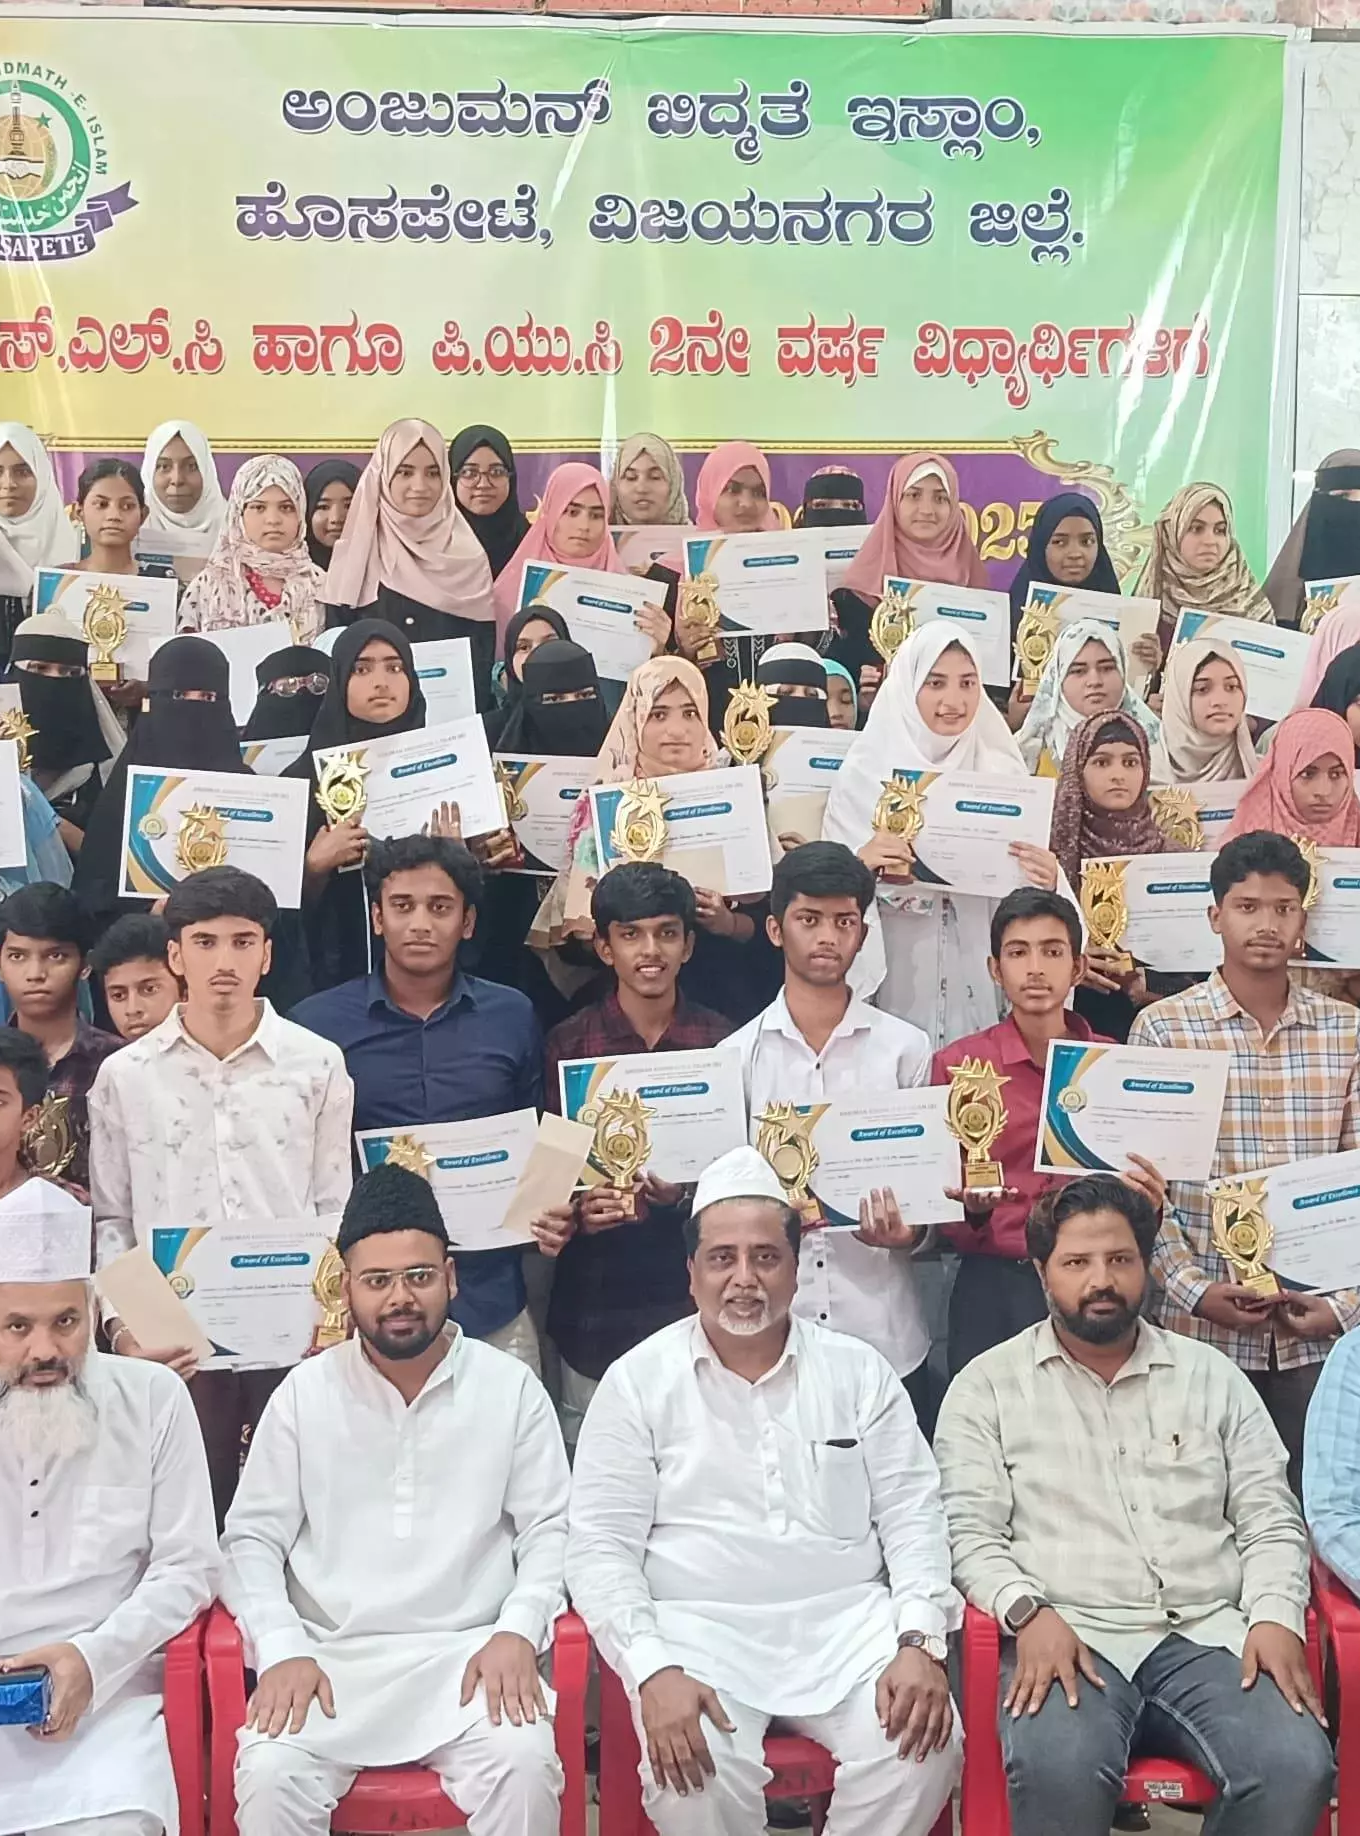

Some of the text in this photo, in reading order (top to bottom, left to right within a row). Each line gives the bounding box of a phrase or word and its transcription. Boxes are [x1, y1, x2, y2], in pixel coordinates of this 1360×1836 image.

[283, 77, 1041, 164] ಅಂಜುಮನ್ ಖಿದ್ಮತೆ ಇಸ್ಲಾಂ,
[86, 116, 107, 175] ISLAM
[235, 181, 1084, 264] ಹೊಸಪೇಟೆ, ವಿಜಯನಗರ ಜಿಲ್ಲೆ.
[251, 308, 406, 376] ಹಾಗೂ
[431, 310, 624, 375] ಪಿ.ಯು.ಸಿ
[648, 308, 751, 375] 2ನೇ
[776, 310, 887, 388] ವರ್ಷ
[397, 764, 416, 775] Award
[962, 802, 980, 811] Award
[237, 810, 267, 819] Excellence
[670, 809, 689, 818] Award
[1152, 884, 1171, 892] Award
[643, 1086, 664, 1095] Award
[672, 1084, 703, 1093] Excellence
[1129, 1081, 1150, 1089] Award
[1158, 1083, 1189, 1091] Excellence
[857, 1129, 878, 1138] Award
[886, 1127, 918, 1136] Excellence
[443, 1157, 463, 1166] Award
[471, 1152, 502, 1163] Excellence
[1299, 1195, 1319, 1206] Award
[1328, 1187, 1359, 1200] Excellence
[238, 1256, 260, 1265] Award
[269, 1254, 303, 1264] Excellence
